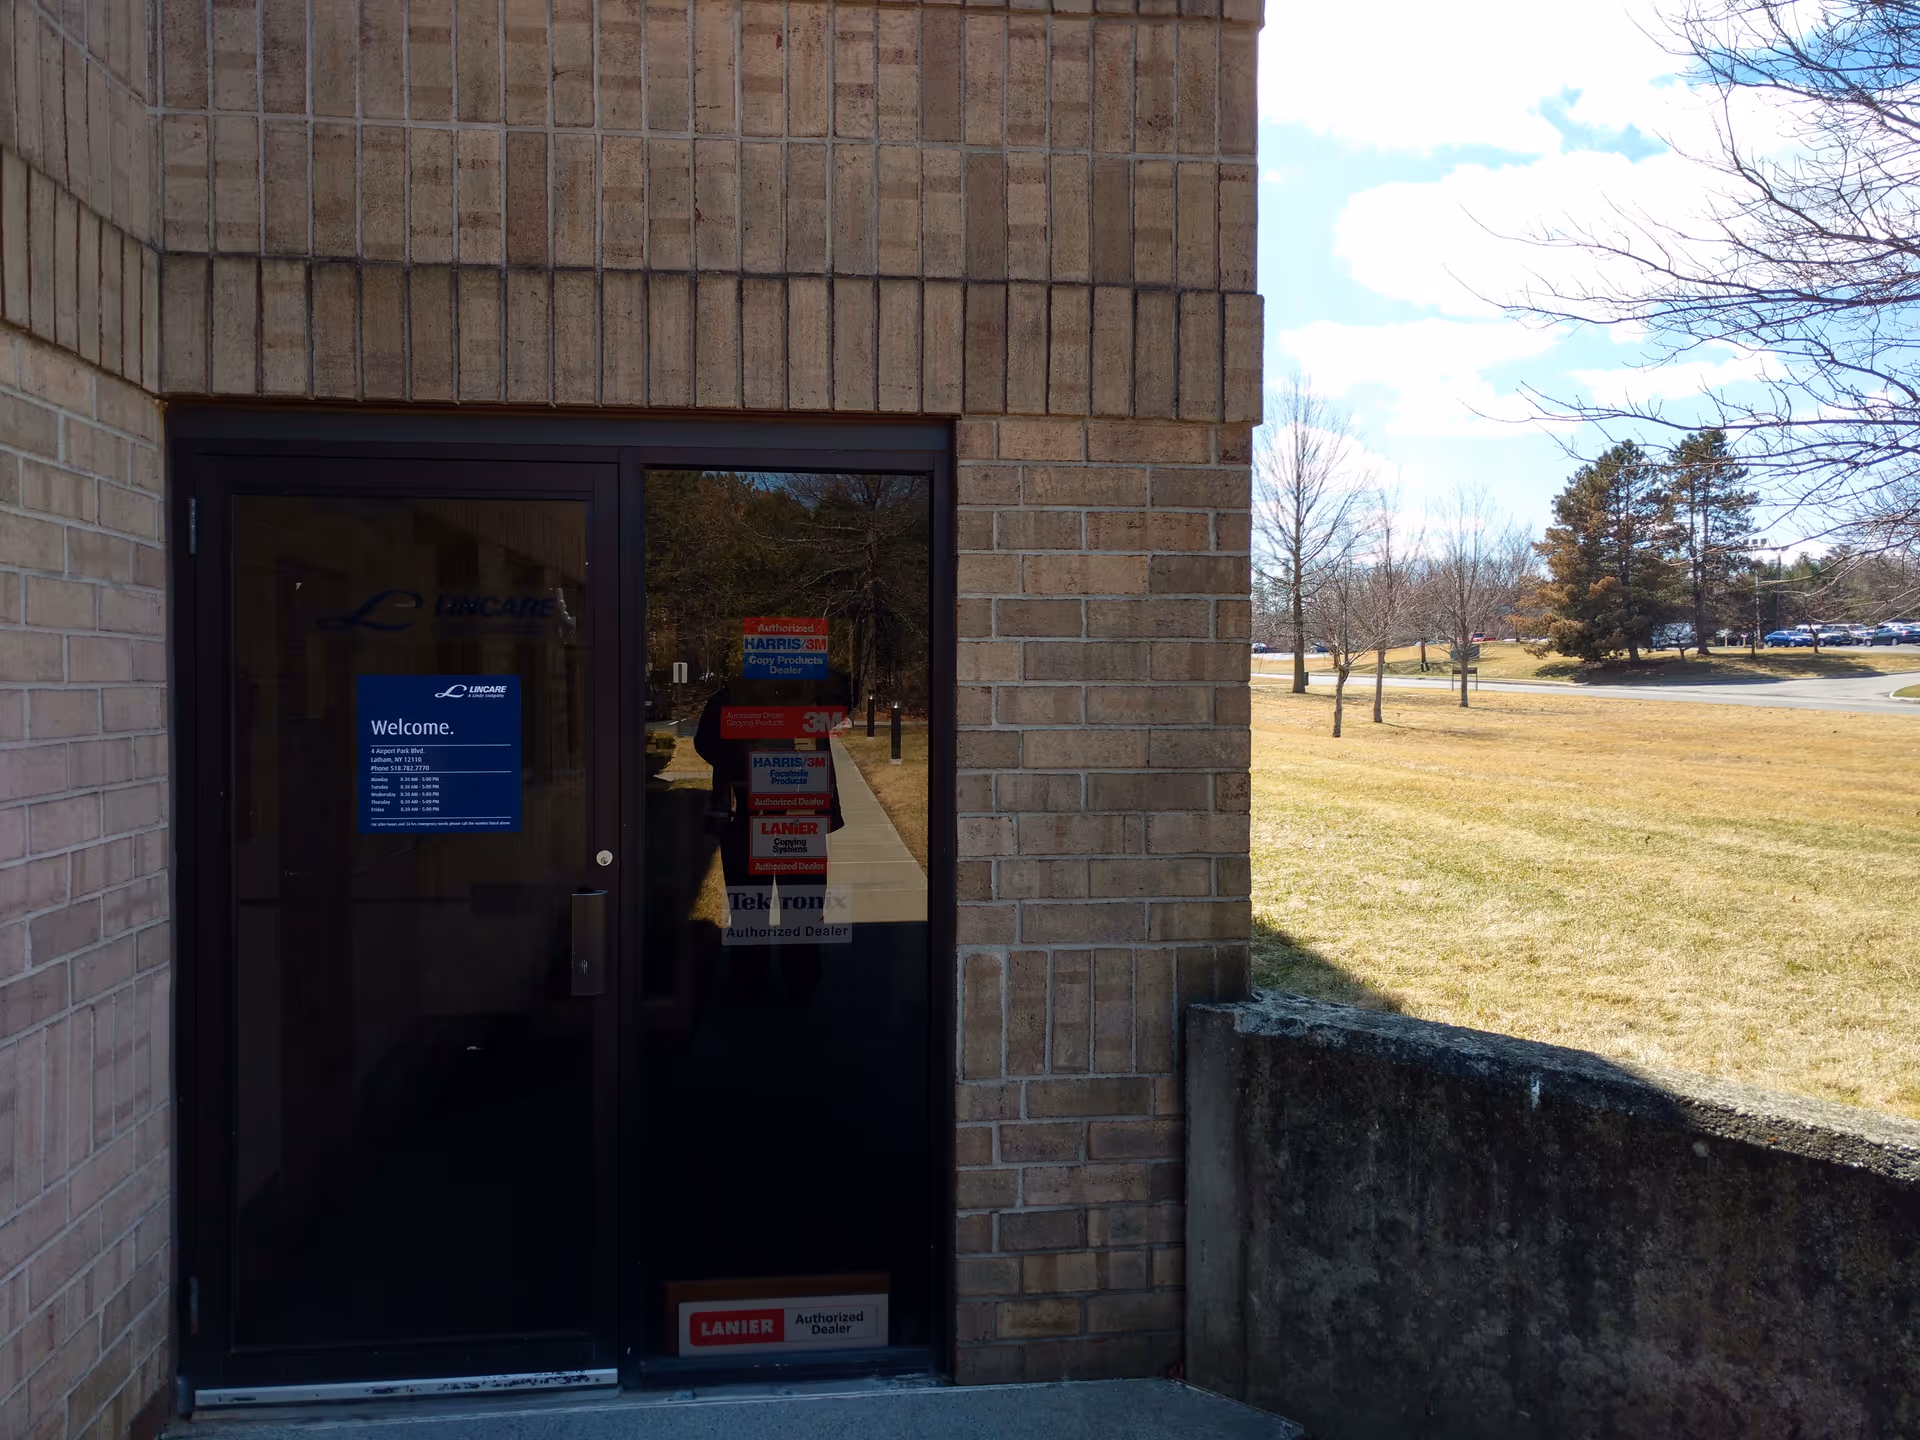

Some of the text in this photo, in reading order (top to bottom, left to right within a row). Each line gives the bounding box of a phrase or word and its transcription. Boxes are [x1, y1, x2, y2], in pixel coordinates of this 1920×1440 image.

[434, 593, 557, 618] LINCARE
[758, 623, 814, 632] Authorized
[744, 638, 827, 650] HARRIS/3M
[749, 655, 823, 665] Copy Products
[769, 666, 803, 674] Dealer
[469, 685, 508, 693] LINCARE
[371, 718, 454, 735] Welcome.
[755, 719, 785, 727] Products
[802, 711, 843, 733] 3M
[370, 756, 393, 764] Latham,
[753, 757, 825, 768] HARRIS/3M
[771, 777, 807, 785] Products
[761, 821, 818, 835] LANIER
[773, 837, 806, 847] Copying
[772, 846, 807, 854] Systems
[755, 862, 825, 870] Authorized Dealer
[727, 926, 849, 937] Authorized Dealer
[795, 1311, 864, 1324] Authorized
[701, 1319, 775, 1337] LANIER
[811, 1323, 851, 1335] Dealer
